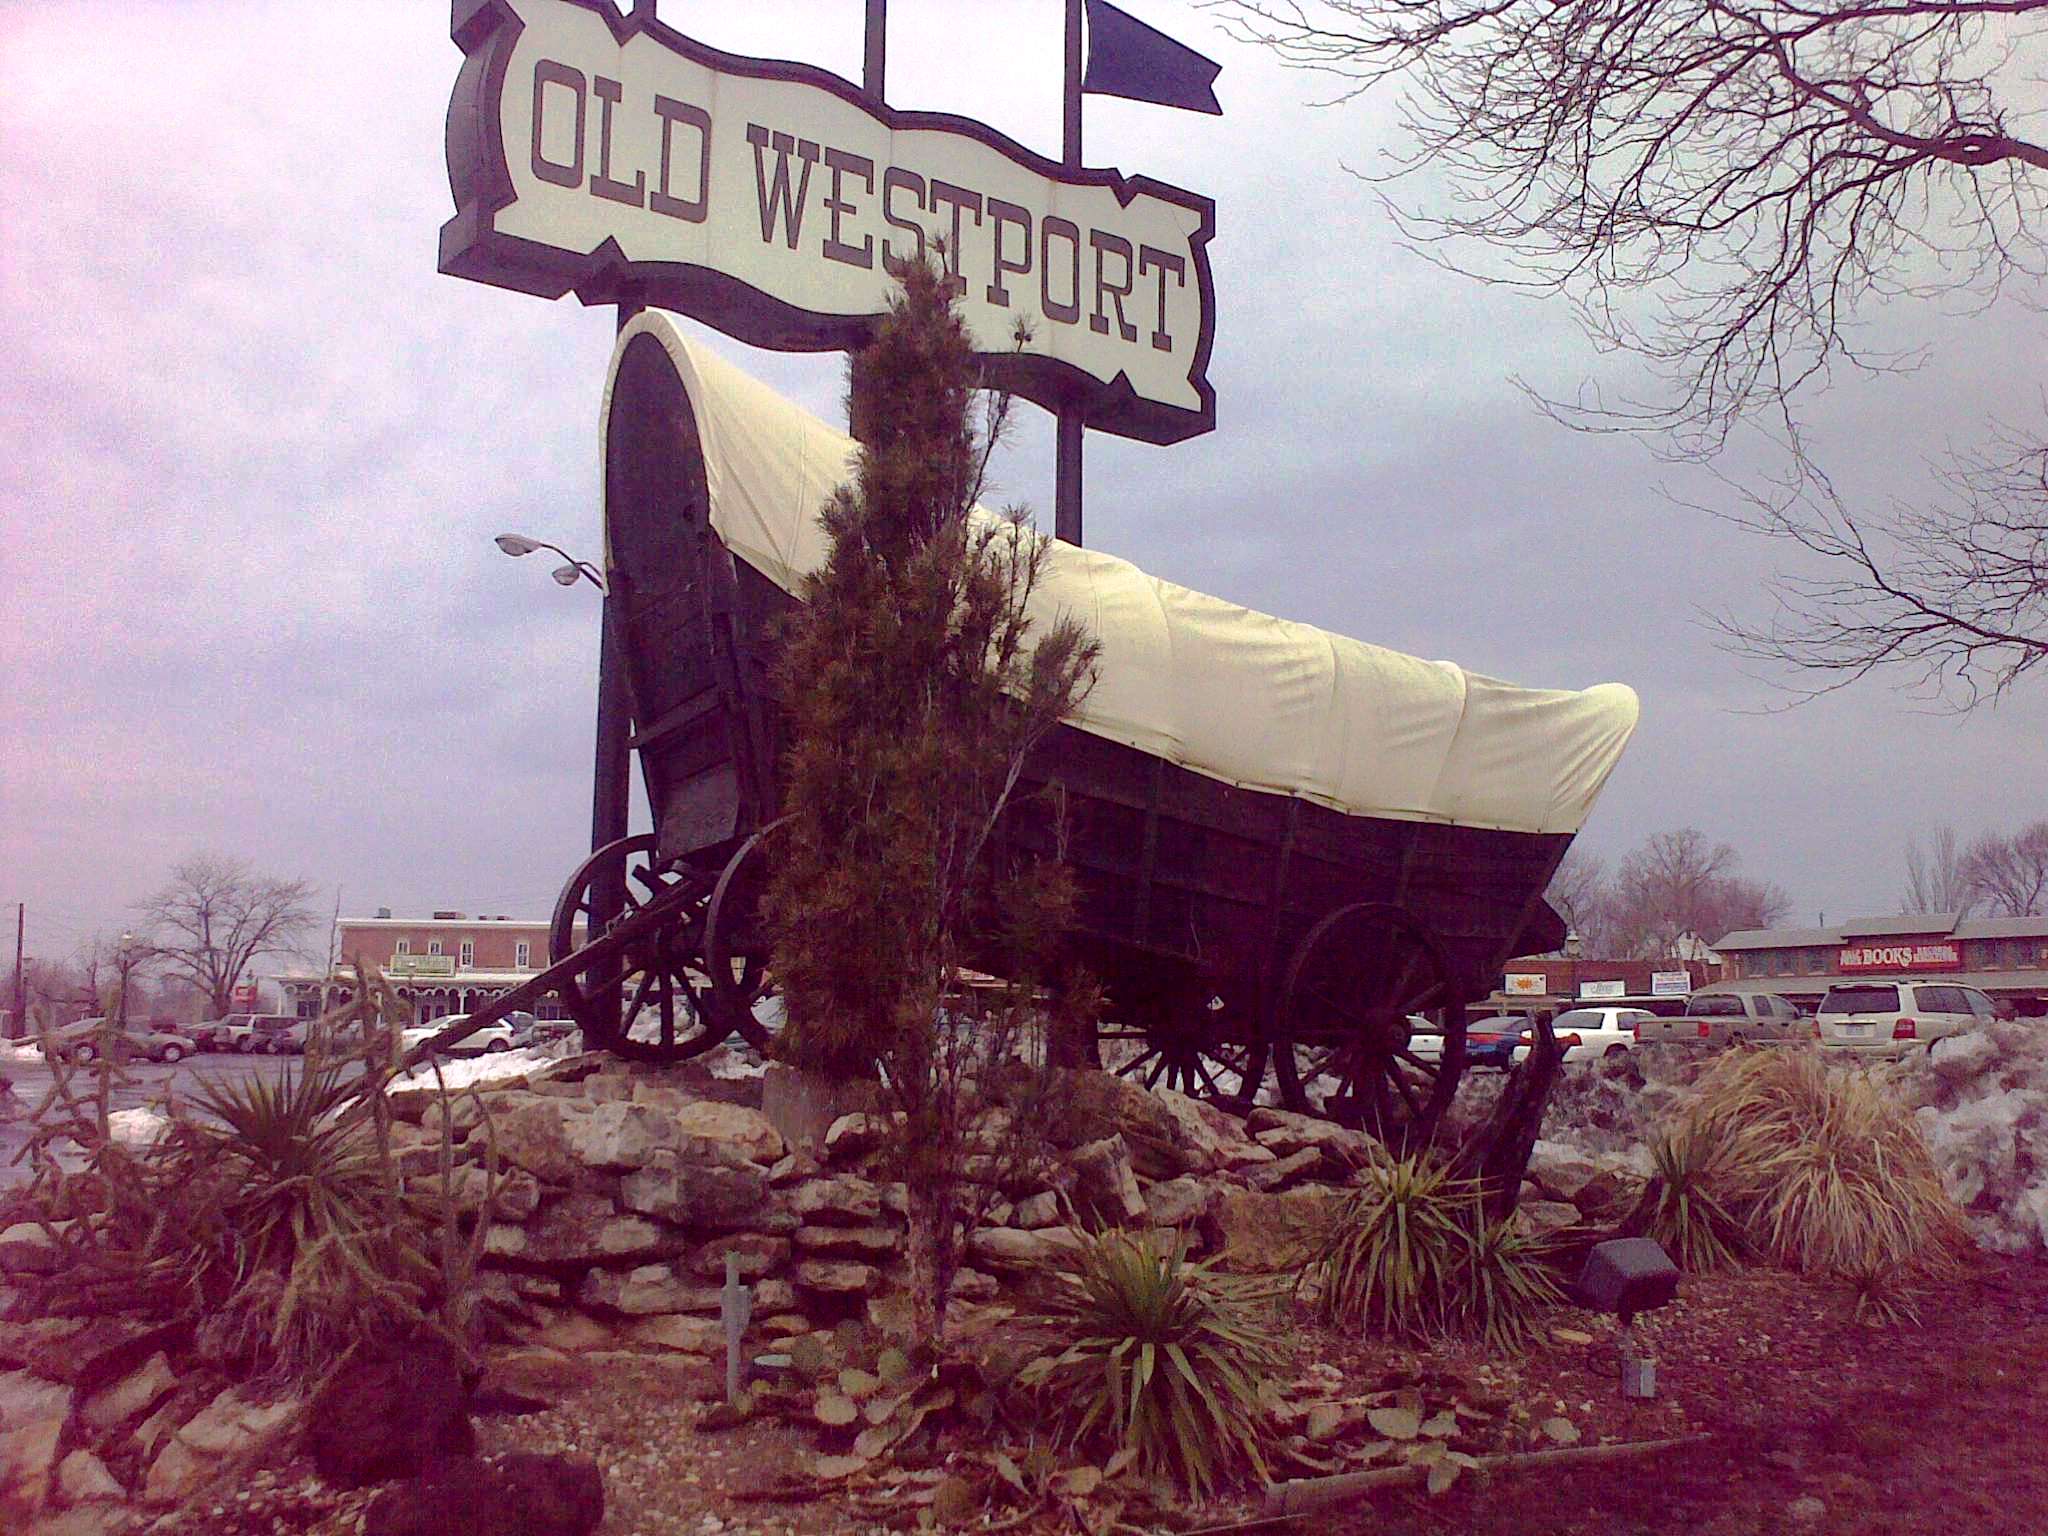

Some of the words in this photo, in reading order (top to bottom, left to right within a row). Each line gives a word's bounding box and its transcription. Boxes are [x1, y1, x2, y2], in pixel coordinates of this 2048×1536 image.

[531, 58, 712, 224] OLD
[746, 122, 1186, 353] WESTPORT
[1862, 946, 1913, 967] BOOKS
